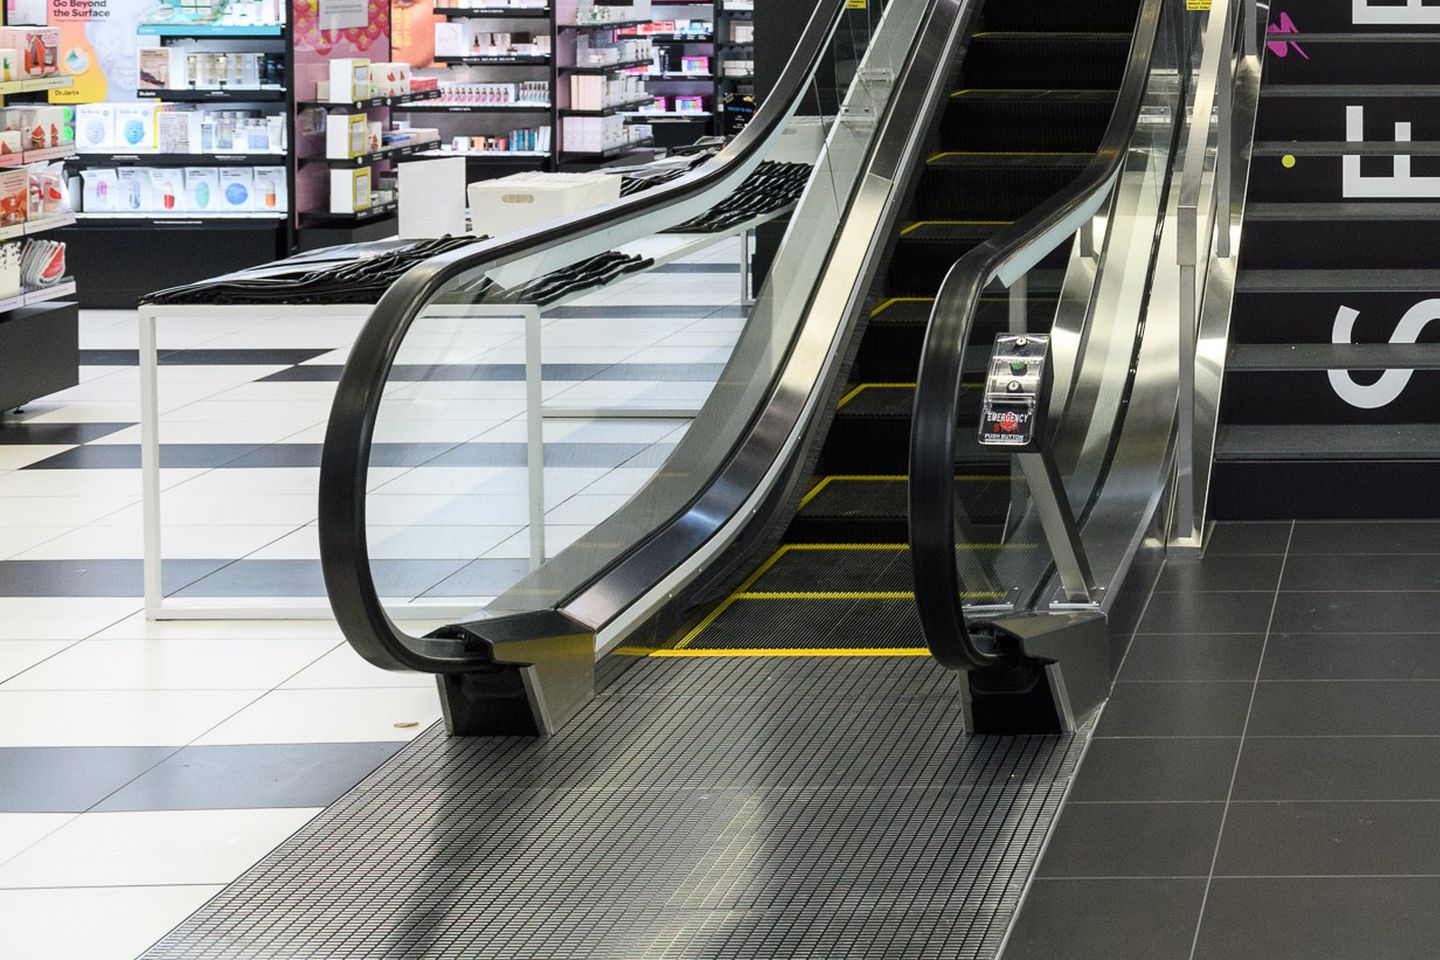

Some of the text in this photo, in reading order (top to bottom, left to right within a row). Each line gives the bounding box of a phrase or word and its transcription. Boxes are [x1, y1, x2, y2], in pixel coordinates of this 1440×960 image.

[53, 0, 107, 9] Go Beyond
[53, 8, 110, 17] the Surface
[987, 411, 1030, 423] EMERGENCY
